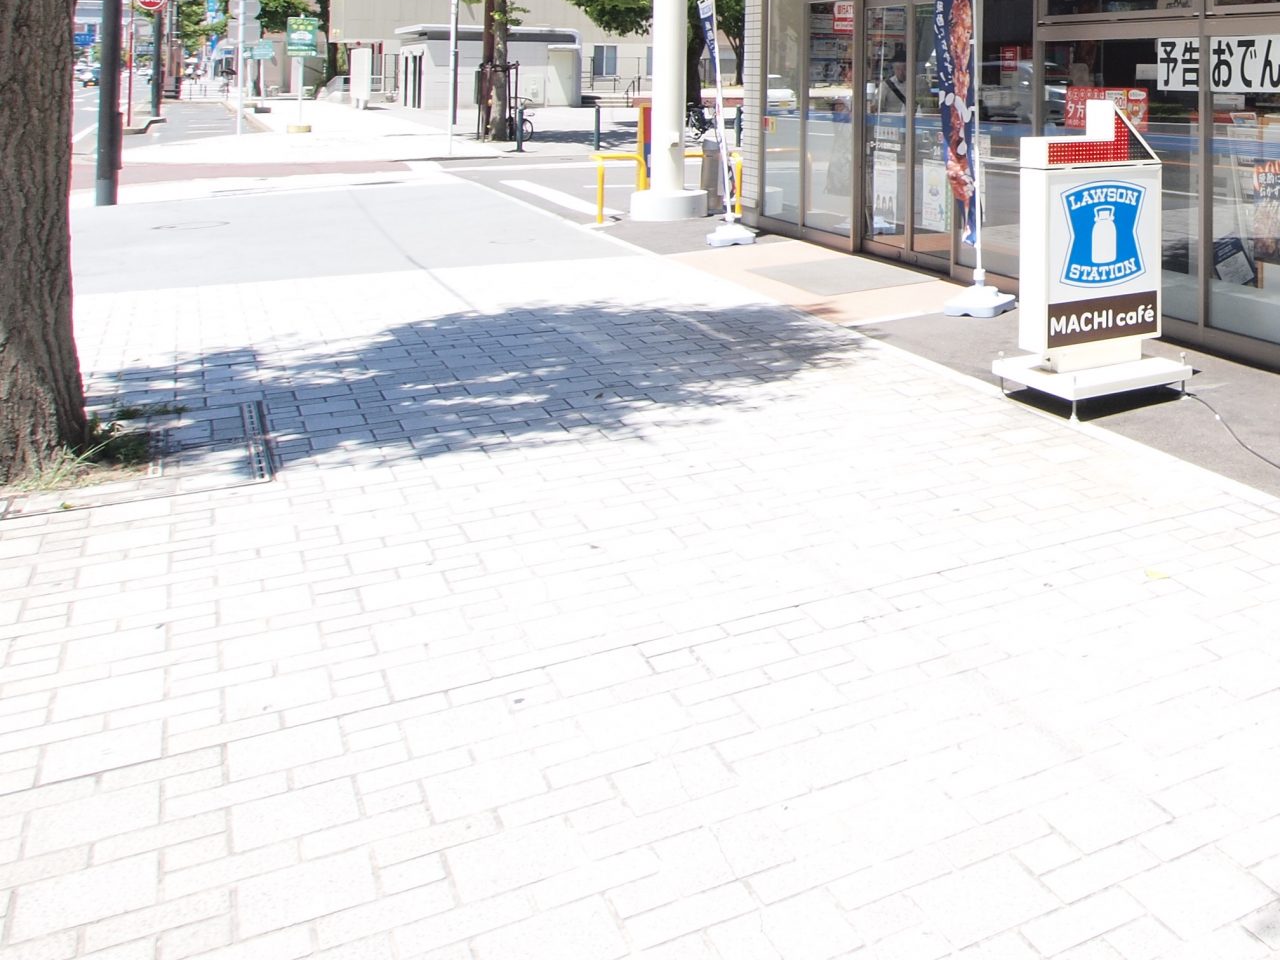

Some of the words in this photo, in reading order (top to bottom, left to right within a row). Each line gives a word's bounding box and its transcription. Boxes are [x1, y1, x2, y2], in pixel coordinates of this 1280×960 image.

[1160, 40, 1200, 87] 予告
[1069, 187, 1139, 210] LAWSON
[1069, 258, 1137, 281] STATION
[1050, 309, 1113, 336] MACHI
[1116, 304, 1155, 327] café
